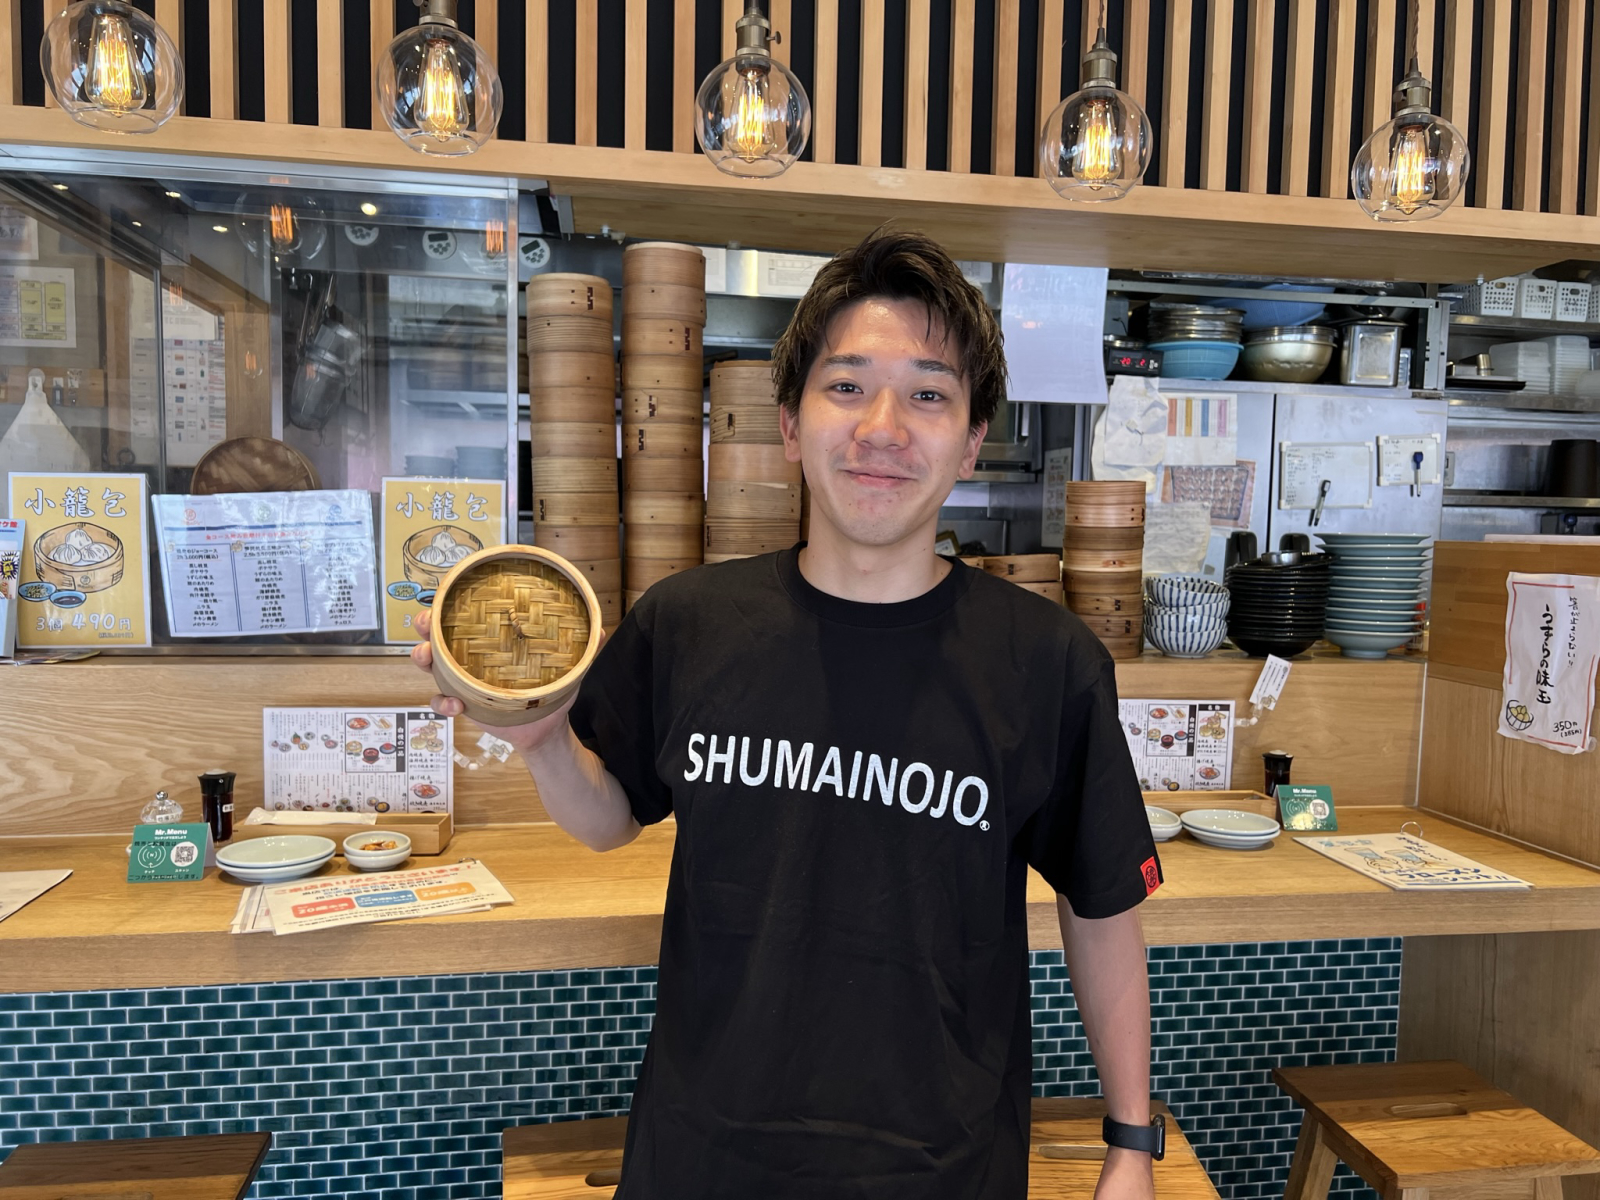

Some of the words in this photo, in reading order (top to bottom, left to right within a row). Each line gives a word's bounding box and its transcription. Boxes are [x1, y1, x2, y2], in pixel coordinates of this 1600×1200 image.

[25, 486, 127, 518] 小籠包
[396, 491, 488, 521] 小籠包
[36, 617, 63, 631] 3個
[72, 613, 131, 631] 490円
[1536, 604, 1554, 704] うずらの味玉
[684, 733, 989, 826] SHUMAINOJO
[157, 814, 182, 822] 台湾スパ
